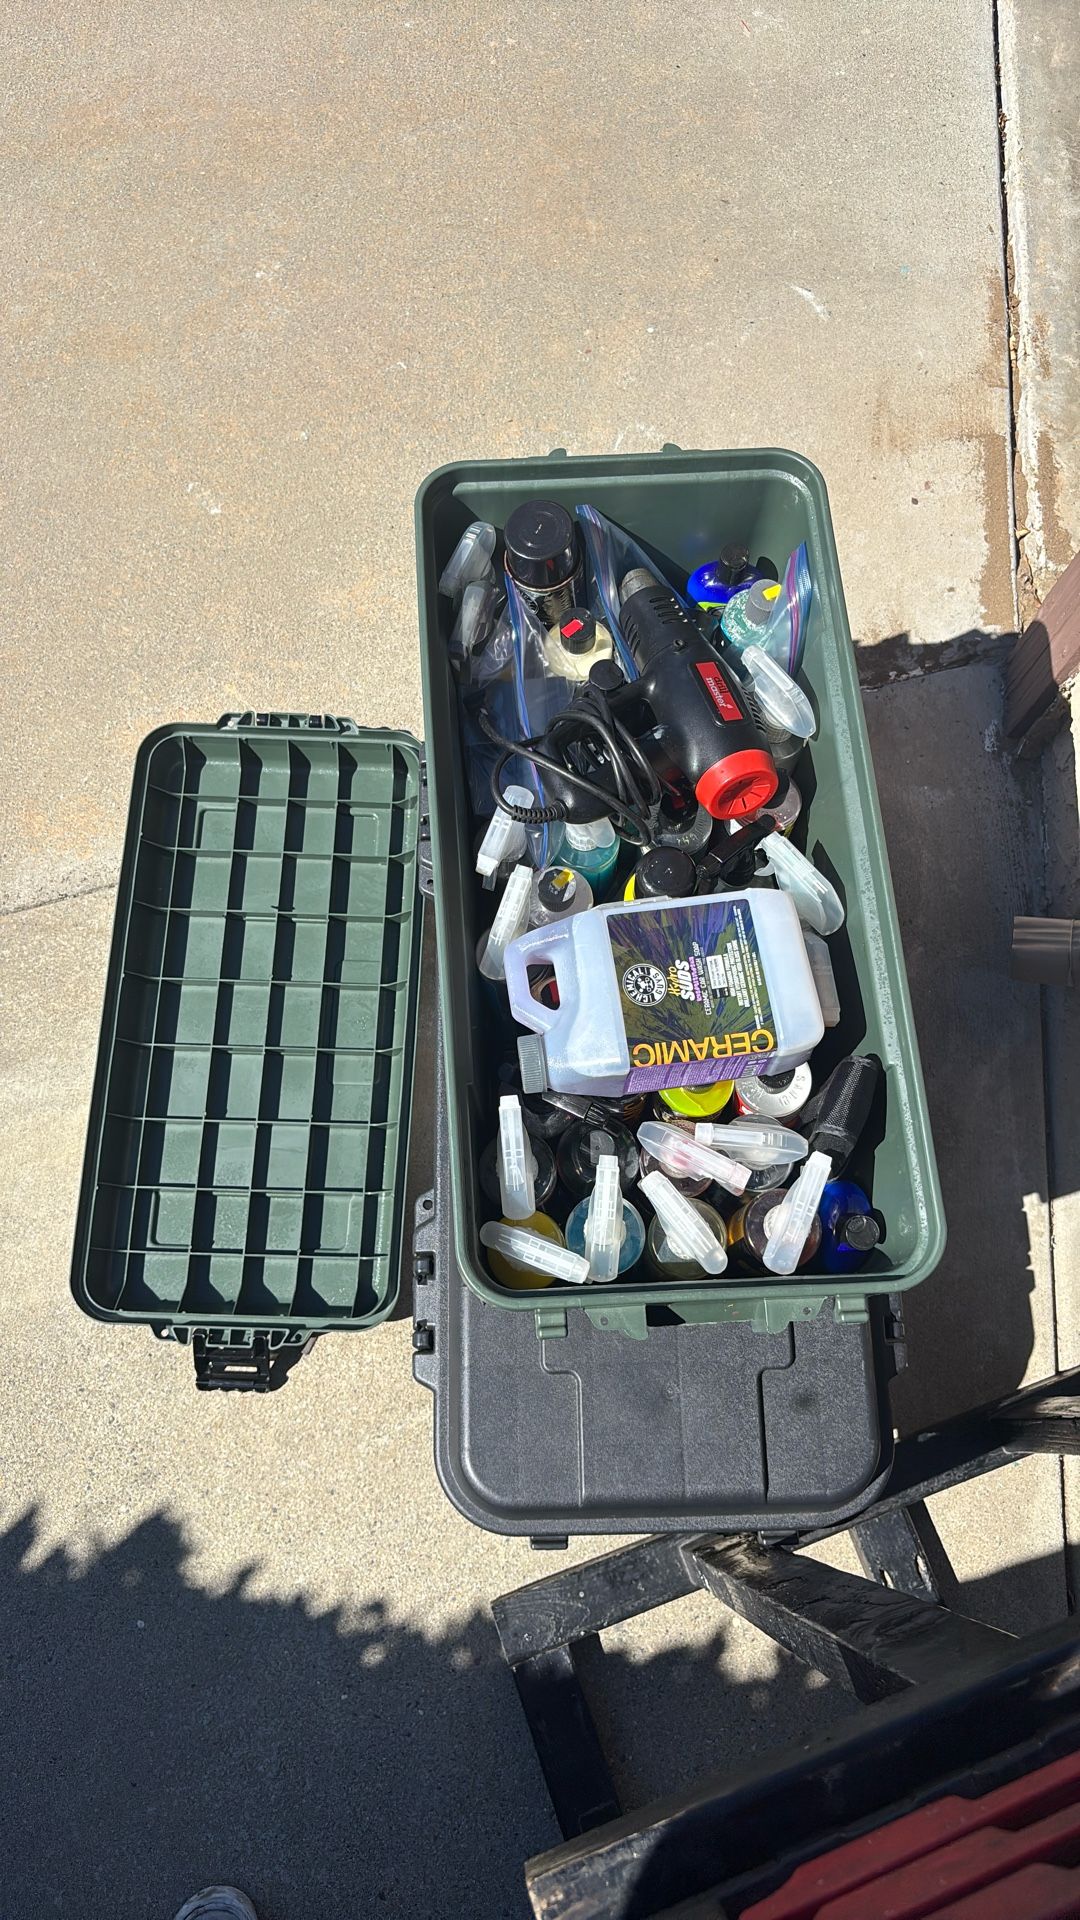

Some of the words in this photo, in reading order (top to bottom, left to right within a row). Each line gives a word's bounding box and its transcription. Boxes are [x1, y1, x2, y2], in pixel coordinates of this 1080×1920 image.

[706, 677, 726, 708] master
[715, 677, 729, 694] drill
[692, 942, 700, 956] SOAP
[675, 960, 695, 1001] SUDS
[695, 958, 704, 975] WASH
[626, 967, 649, 1003] CHEMICAL
[652, 972, 664, 995] GUYS
[667, 966, 682, 997] Hydro
[701, 990, 712, 1015] CERAMIC
[632, 1029, 774, 1067] CERAMIC
